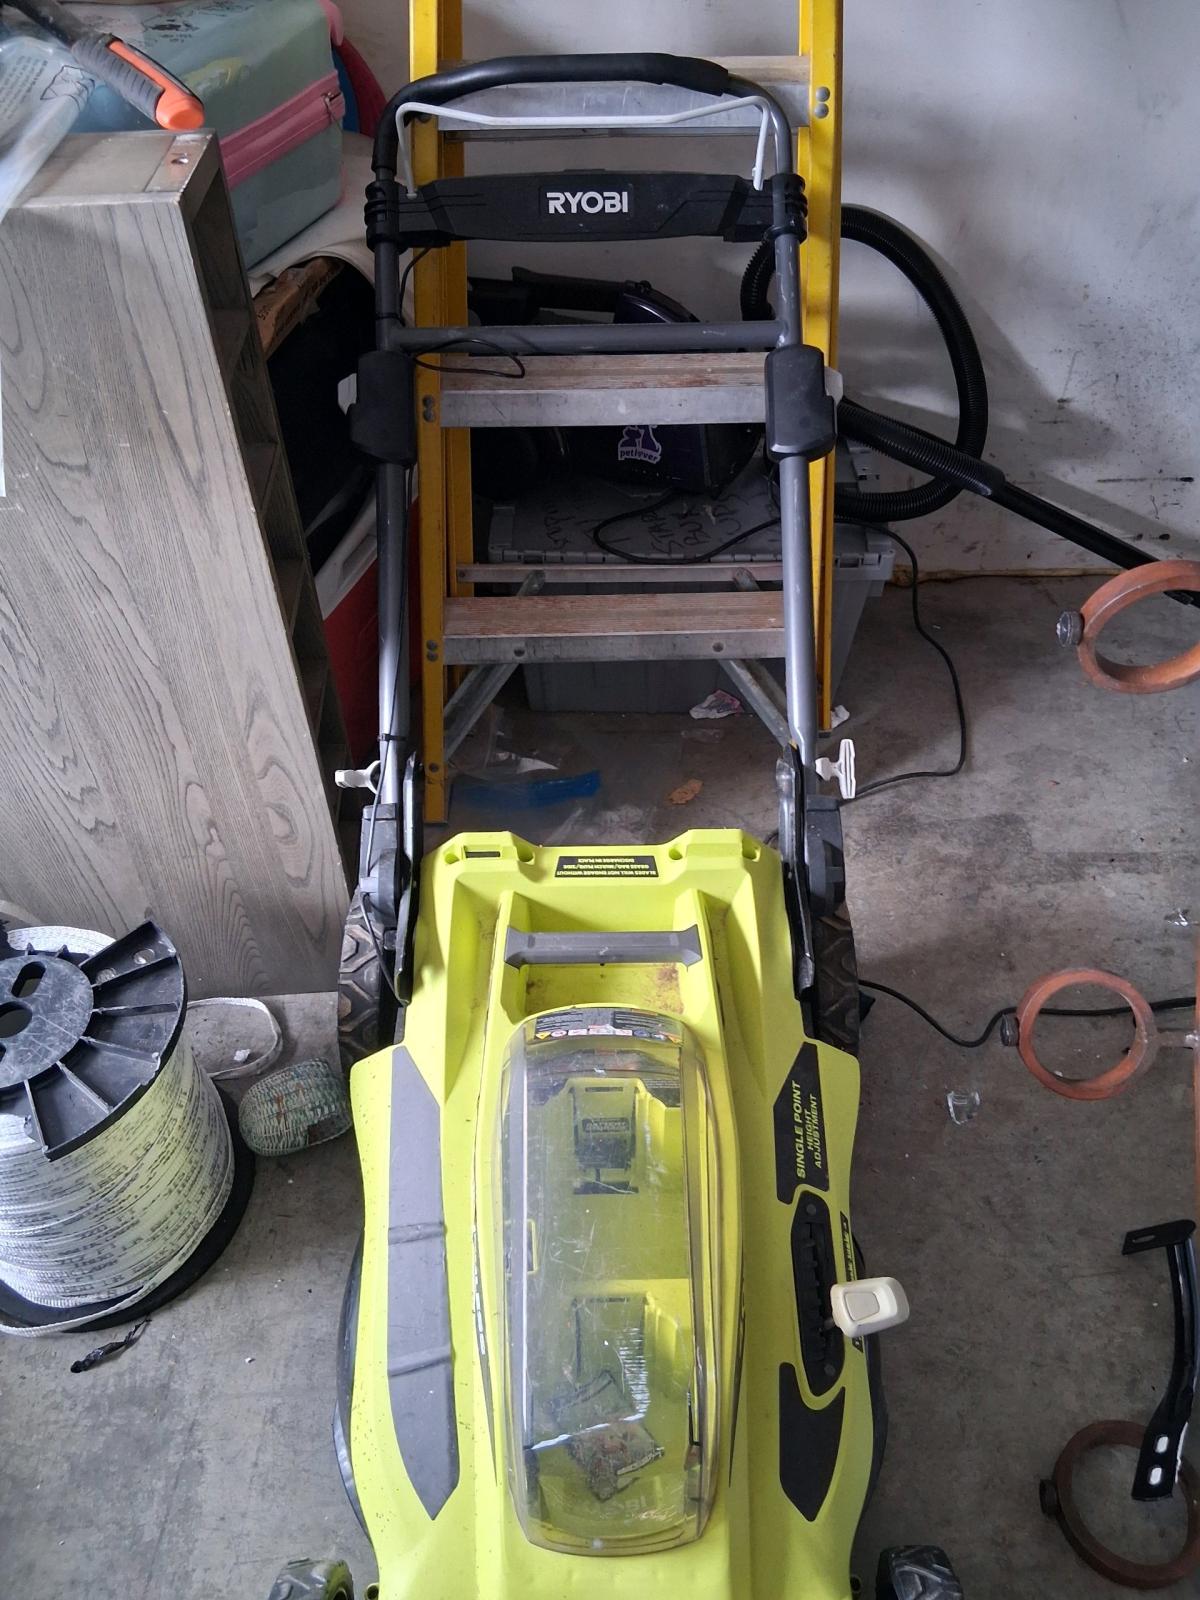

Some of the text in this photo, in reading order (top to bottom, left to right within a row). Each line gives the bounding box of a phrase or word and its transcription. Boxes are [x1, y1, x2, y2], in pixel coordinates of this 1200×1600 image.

[546, 191, 629, 214] RYOBI
[792, 1080, 806, 1179] SINGLE POINT
[804, 1109, 814, 1150] HEIGHT
[810, 1094, 821, 1168] ADJUSTMENT
